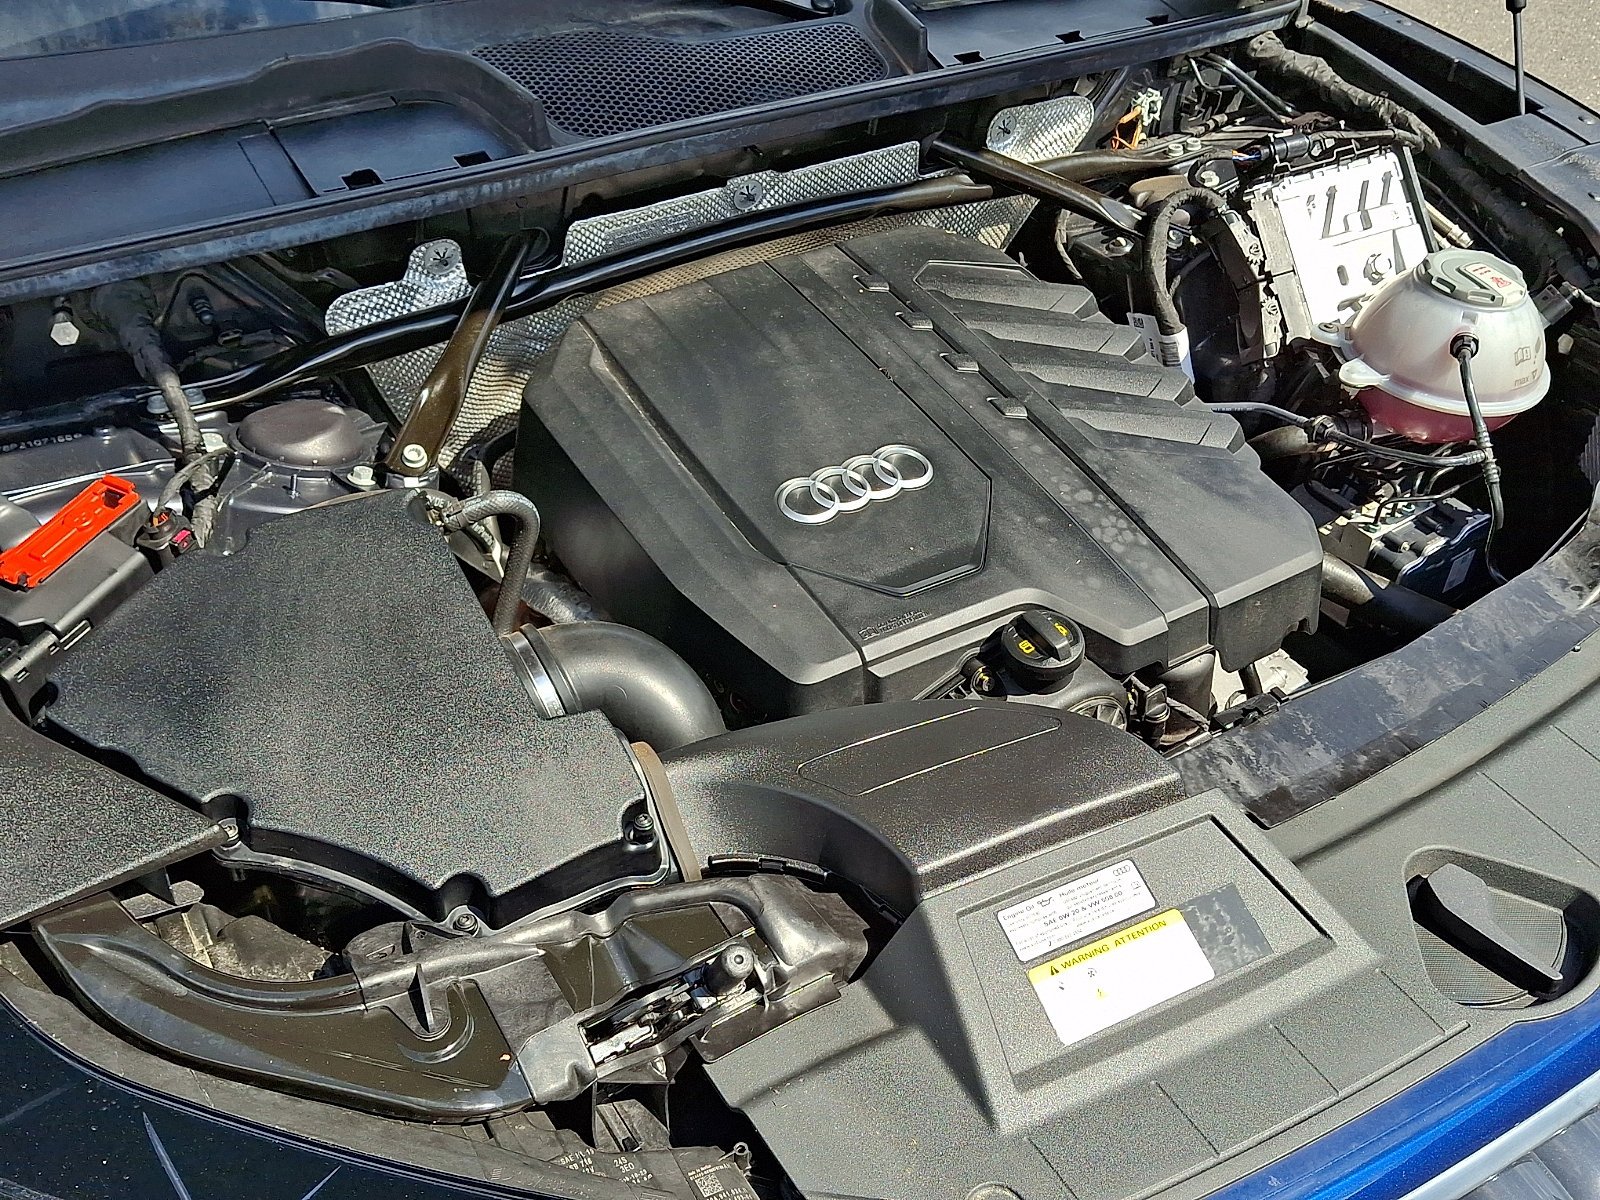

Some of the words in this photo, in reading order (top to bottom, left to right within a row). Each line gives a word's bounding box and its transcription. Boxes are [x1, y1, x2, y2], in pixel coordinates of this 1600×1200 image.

[1514, 375, 1530, 387] max
[1060, 943, 1110, 969] WARNING
[1114, 919, 1167, 947] ATTENTION
